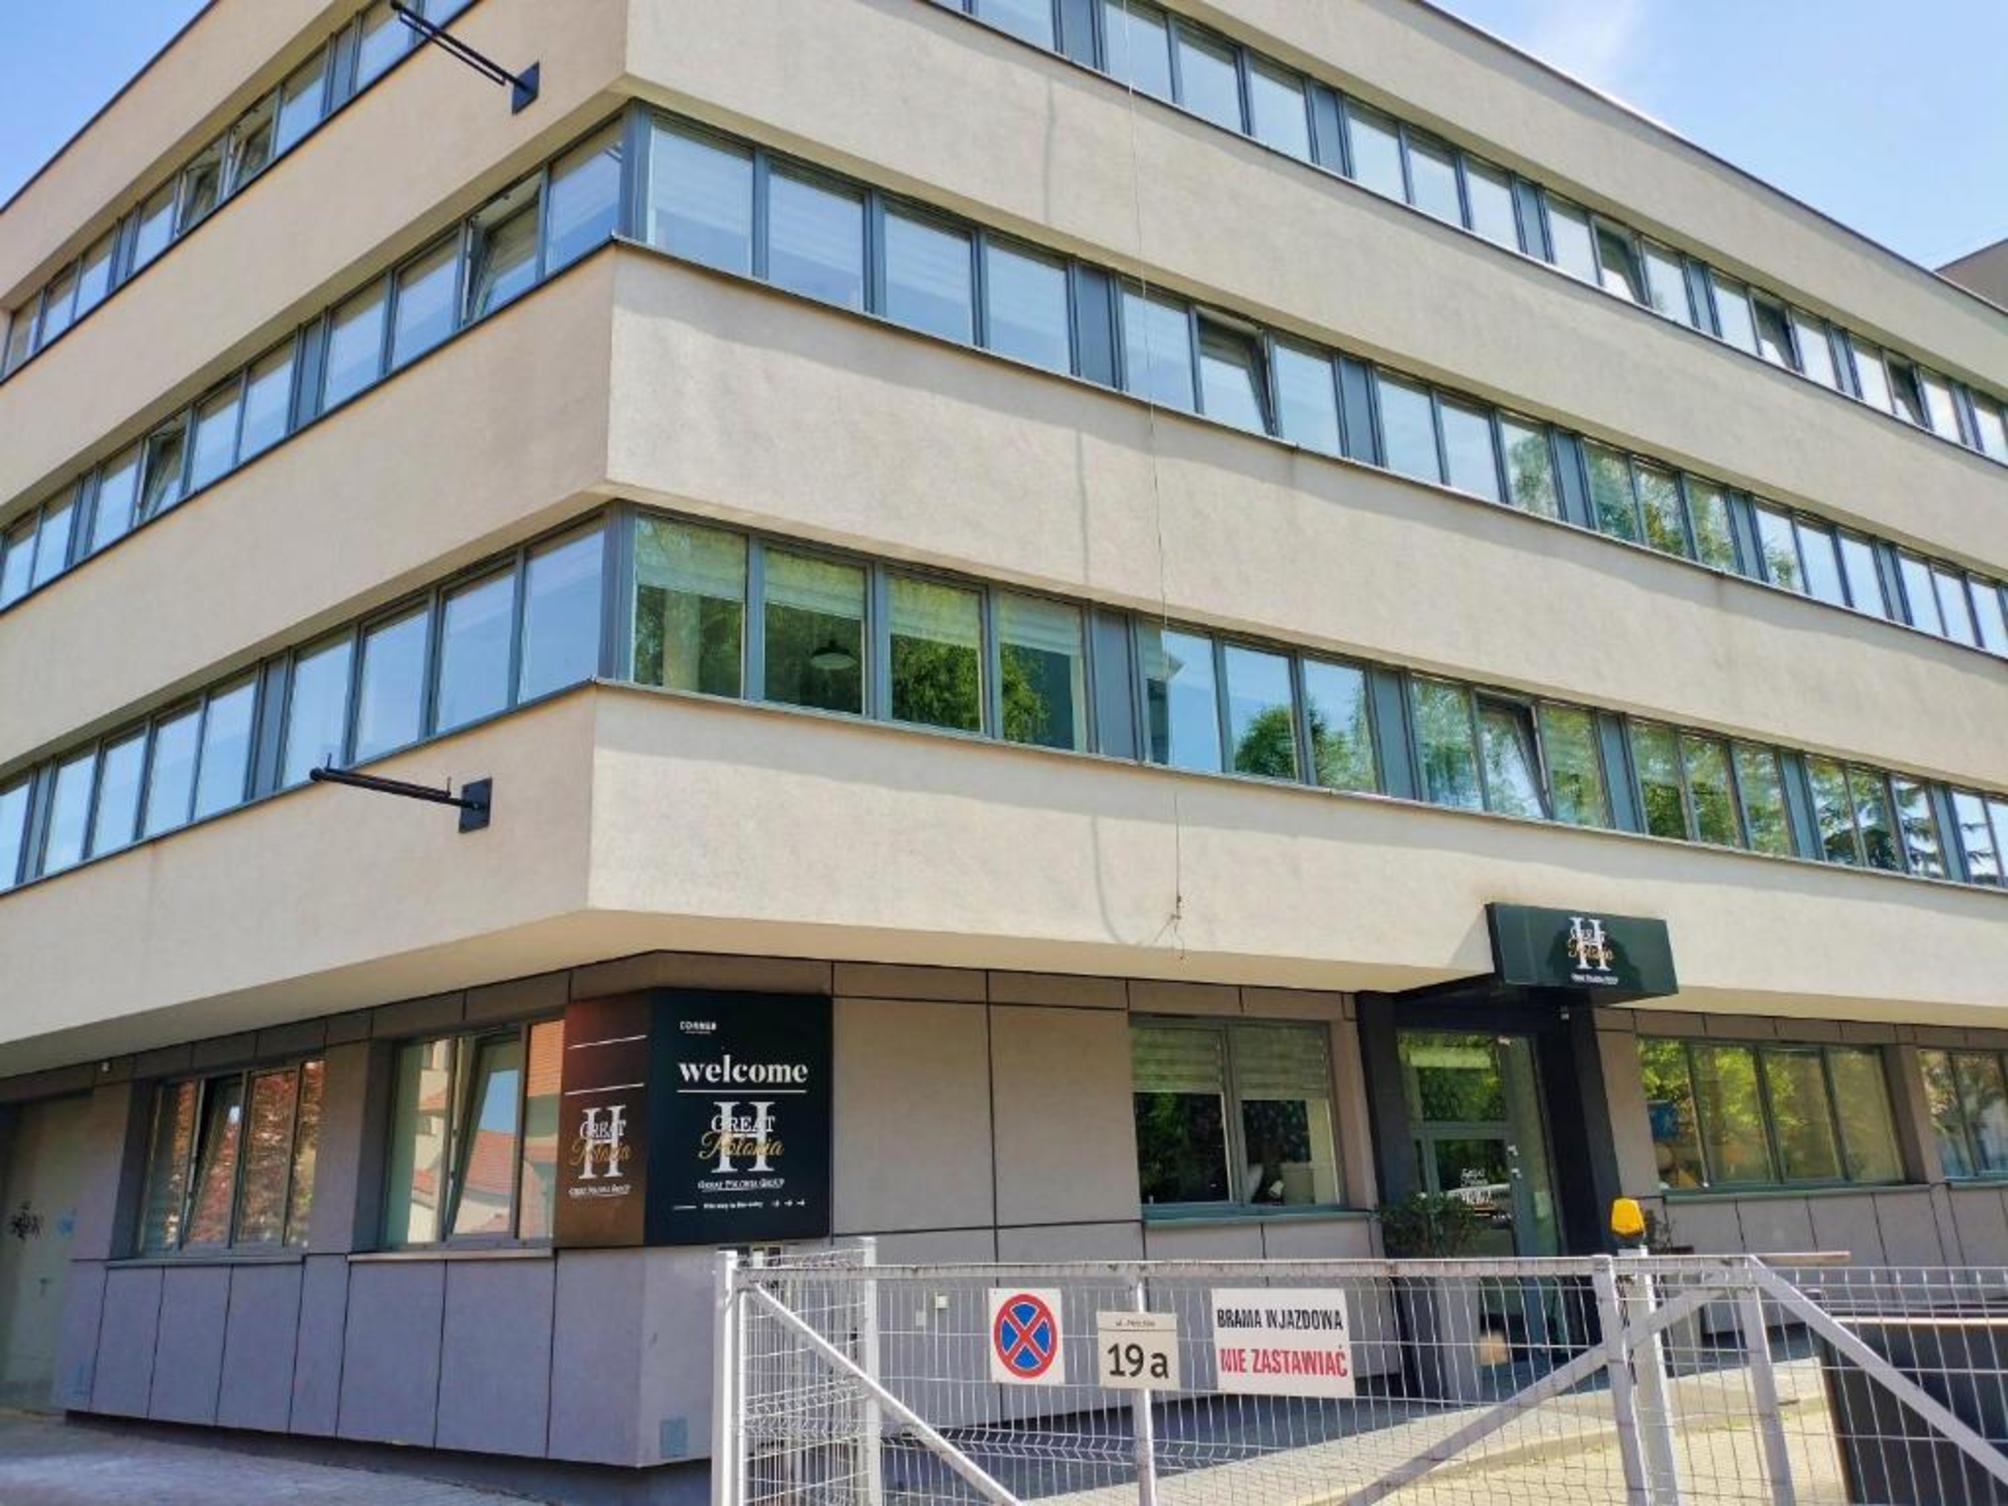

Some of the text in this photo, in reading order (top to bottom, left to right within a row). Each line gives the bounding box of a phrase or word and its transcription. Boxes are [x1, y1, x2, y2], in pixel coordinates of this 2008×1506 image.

[678, 1054, 809, 1083] welcome
[1217, 1309, 1343, 1330] BRAMA WJAZDOWA
[1107, 1343, 1169, 1379] 19a
[1220, 1344, 1348, 1377] NIE ZASTAWIAĆ
